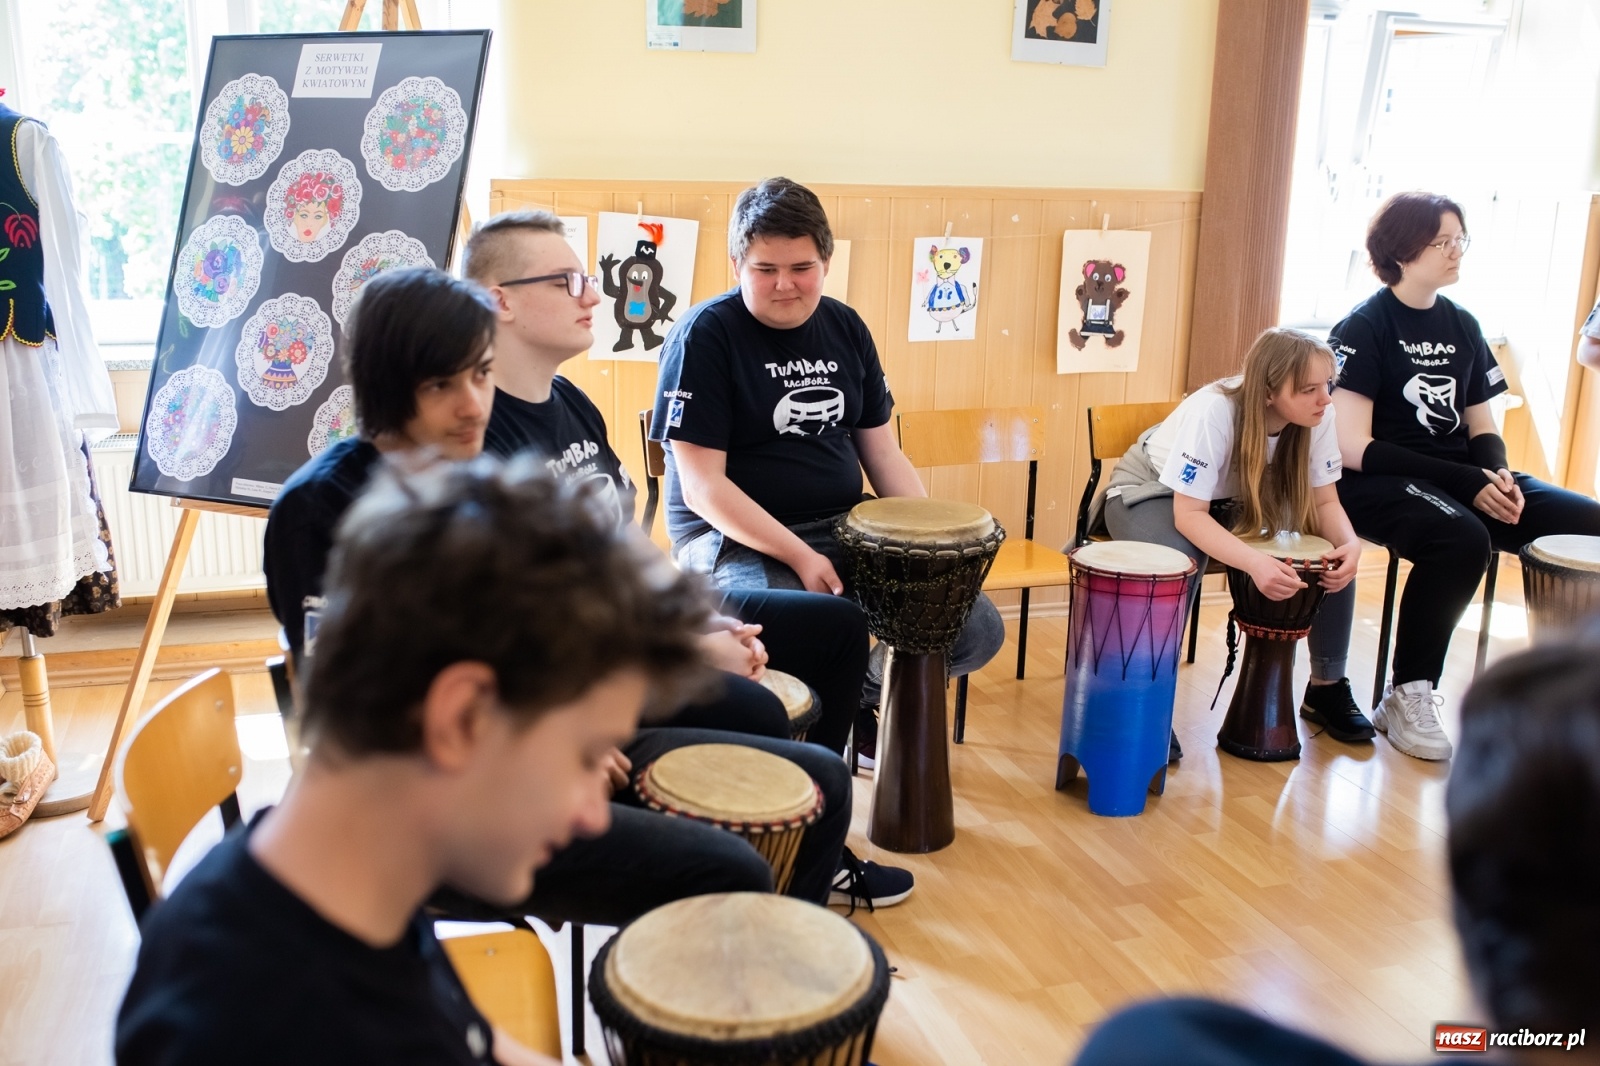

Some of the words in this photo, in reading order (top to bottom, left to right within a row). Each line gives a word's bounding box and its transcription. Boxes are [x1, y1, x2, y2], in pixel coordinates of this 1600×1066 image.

[314, 53, 364, 62] SERWETKI
[304, 66, 312, 75] Z
[315, 66, 369, 75] MOTYWEM
[302, 79, 366, 88] KWIATOWYM
[545, 439, 599, 479] TUMBAO
